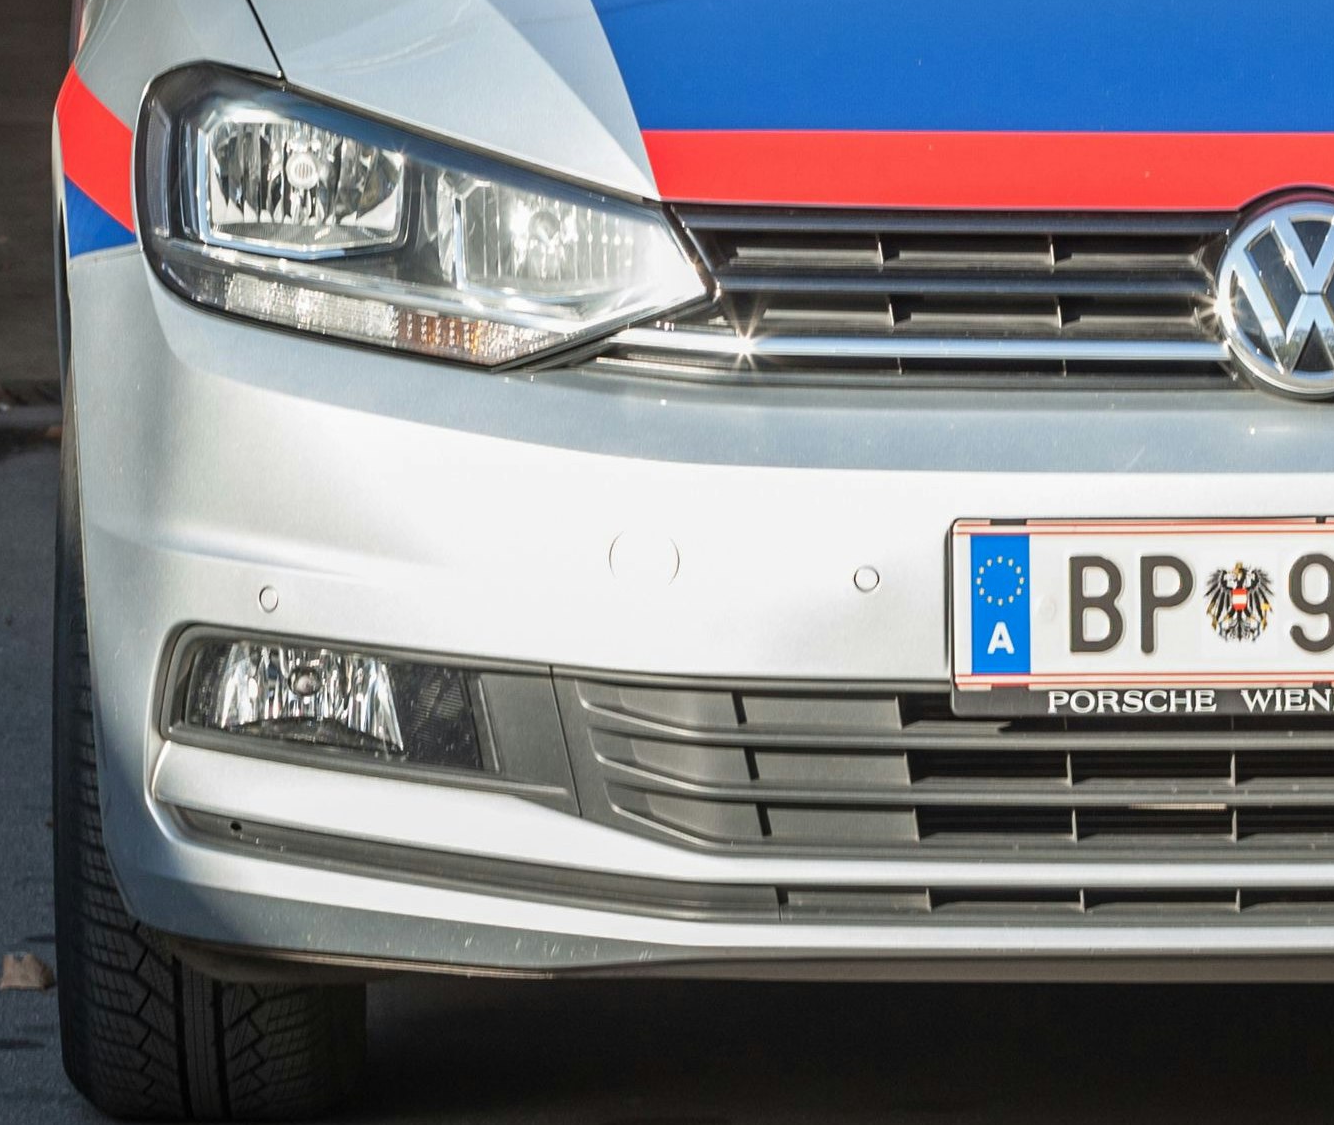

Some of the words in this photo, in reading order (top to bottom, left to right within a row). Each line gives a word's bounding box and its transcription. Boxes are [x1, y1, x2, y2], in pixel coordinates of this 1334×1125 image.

[1067, 555, 1195, 655] BP
[986, 620, 1015, 655] A
[1047, 689, 1217, 714] PORSCHE
